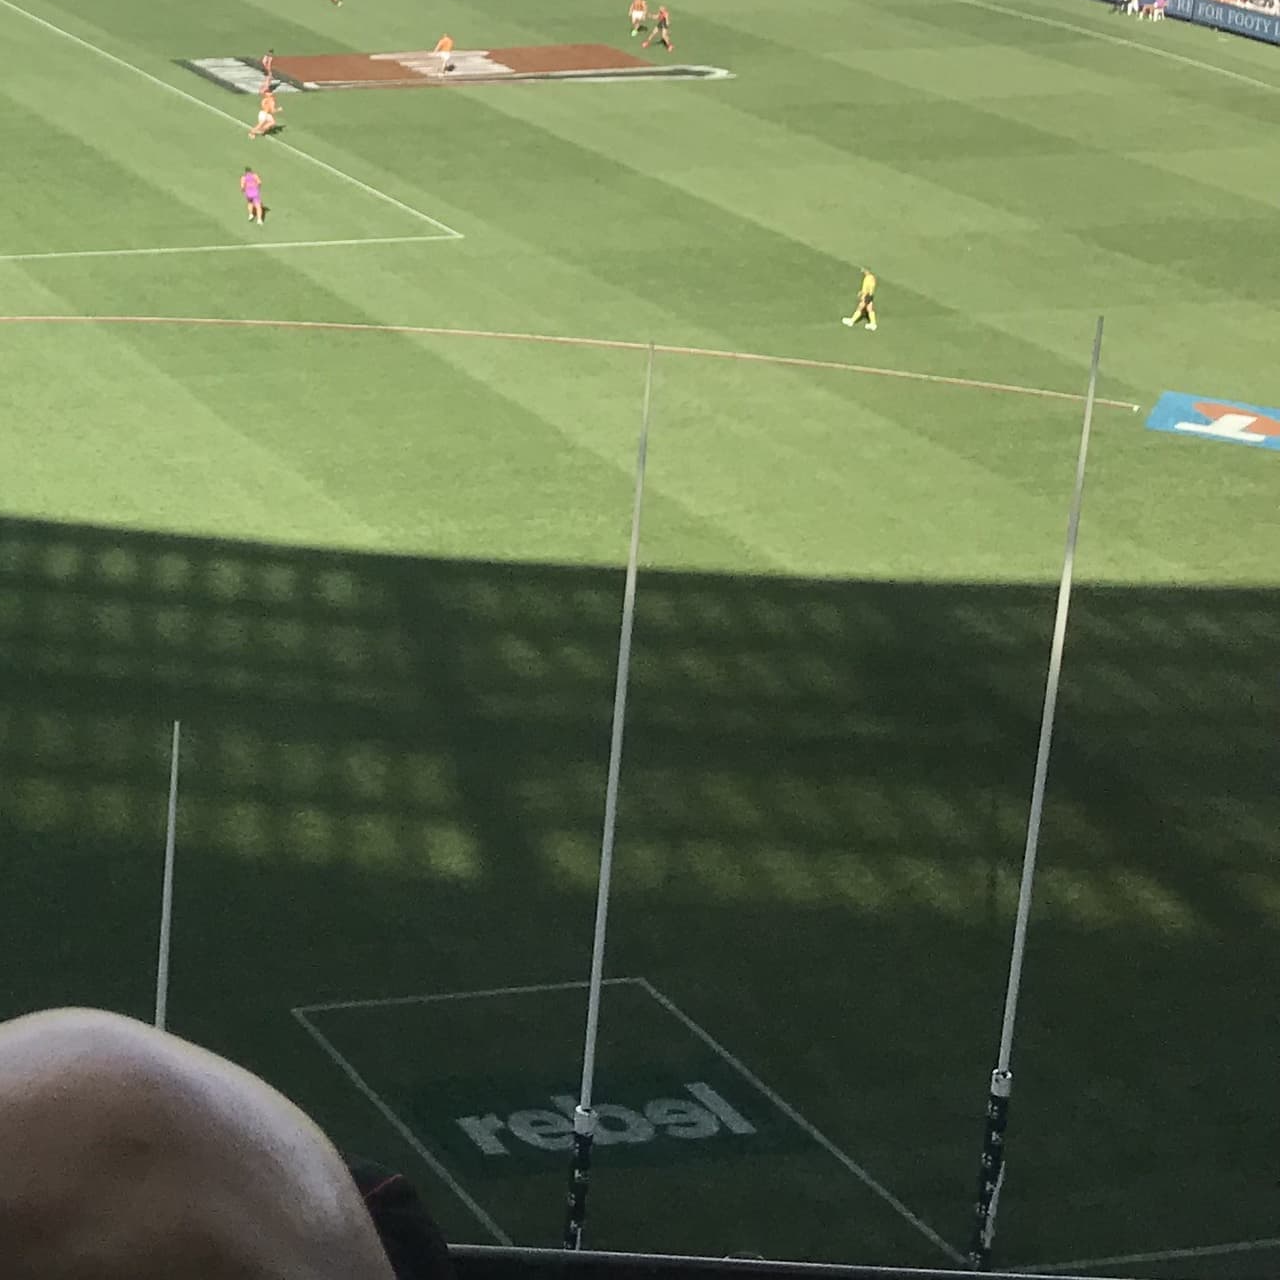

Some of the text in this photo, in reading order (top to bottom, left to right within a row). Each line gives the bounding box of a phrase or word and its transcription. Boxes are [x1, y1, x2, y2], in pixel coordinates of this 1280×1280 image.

[1197, 2, 1273, 32] FOR FOOTY
[456, 1082, 758, 1156] rebel
